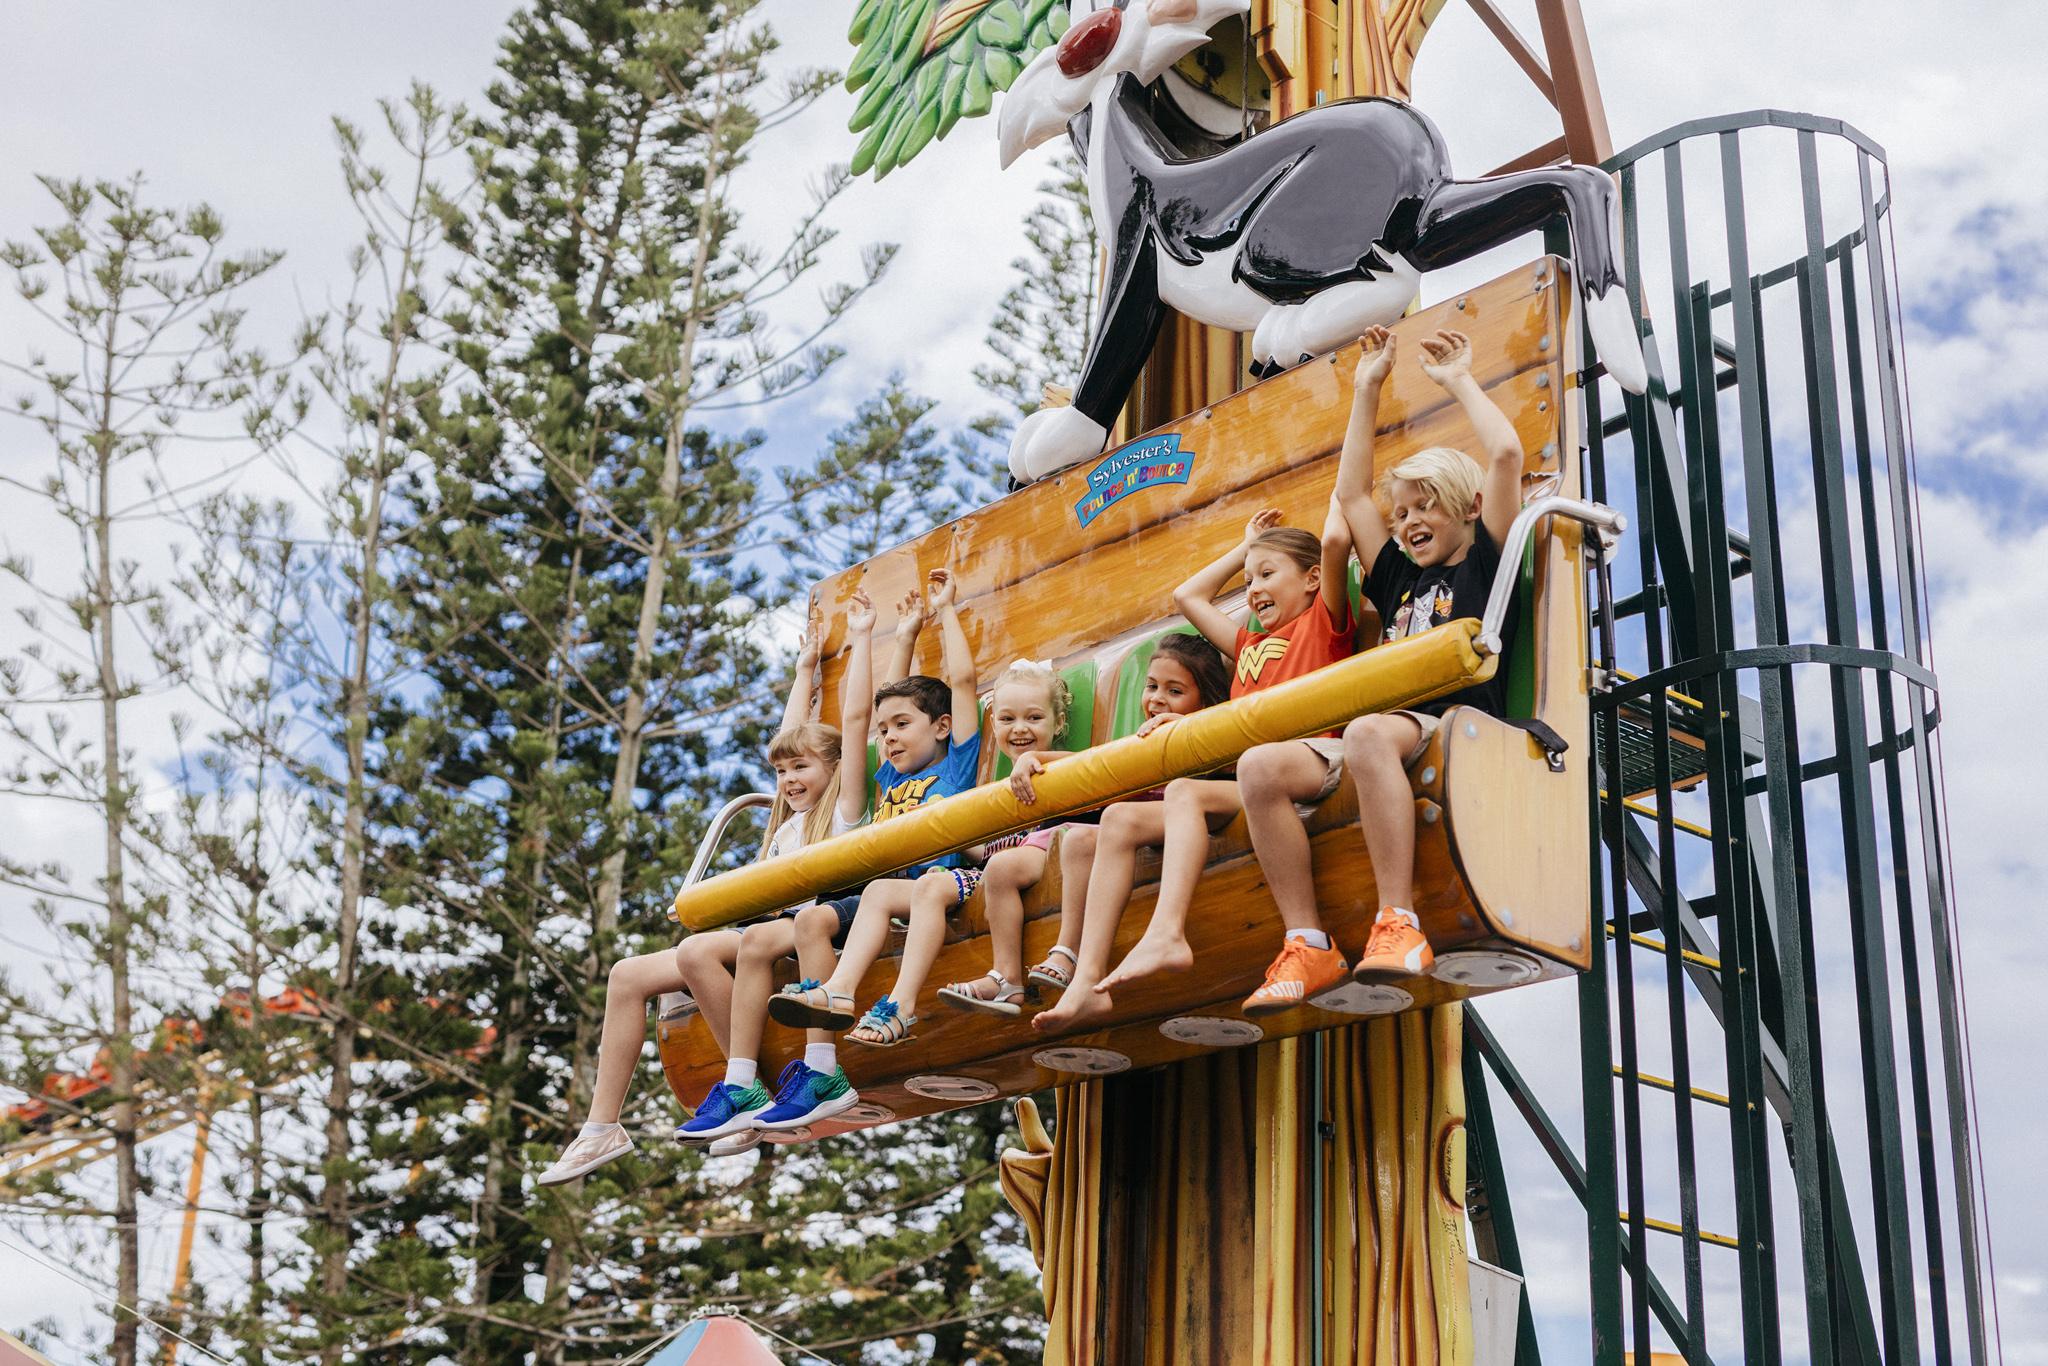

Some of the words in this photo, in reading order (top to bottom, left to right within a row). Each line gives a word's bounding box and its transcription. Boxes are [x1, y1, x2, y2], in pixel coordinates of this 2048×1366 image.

[1093, 439, 1172, 487] Sylvester's
[1081, 481, 1125, 519] Pounce
[1139, 462, 1185, 483] Bounce
